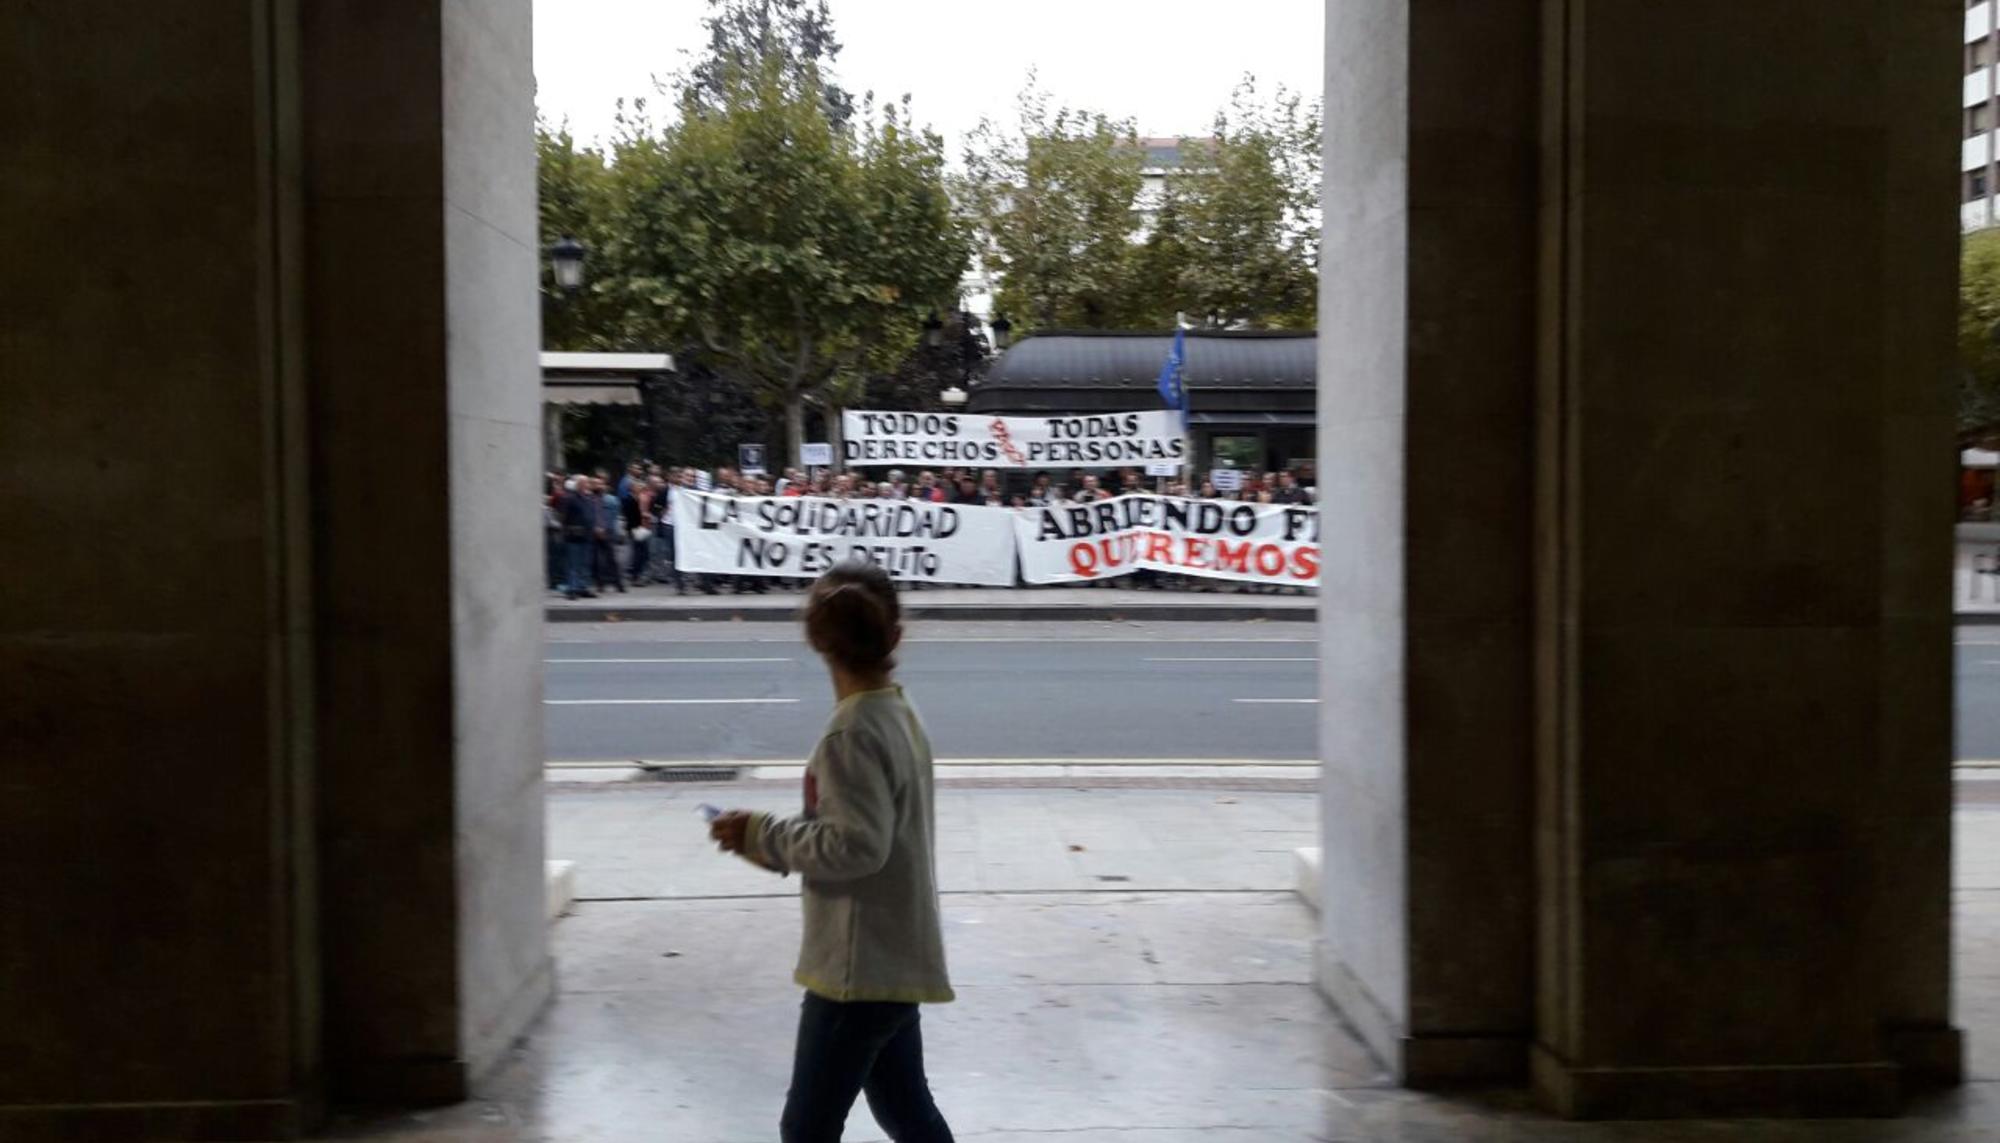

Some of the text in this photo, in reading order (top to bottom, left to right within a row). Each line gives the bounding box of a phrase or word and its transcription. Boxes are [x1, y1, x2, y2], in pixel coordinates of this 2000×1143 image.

[863, 413, 1139, 438] TODOS TODAS
[845, 439, 998, 462] DERECHOS
[1027, 438, 1184, 462] PERSONAS
[698, 496, 739, 530] LA
[1037, 497, 1257, 541] ABRIENDO
[737, 537, 788, 569] NO
[802, 542, 834, 572] ES
